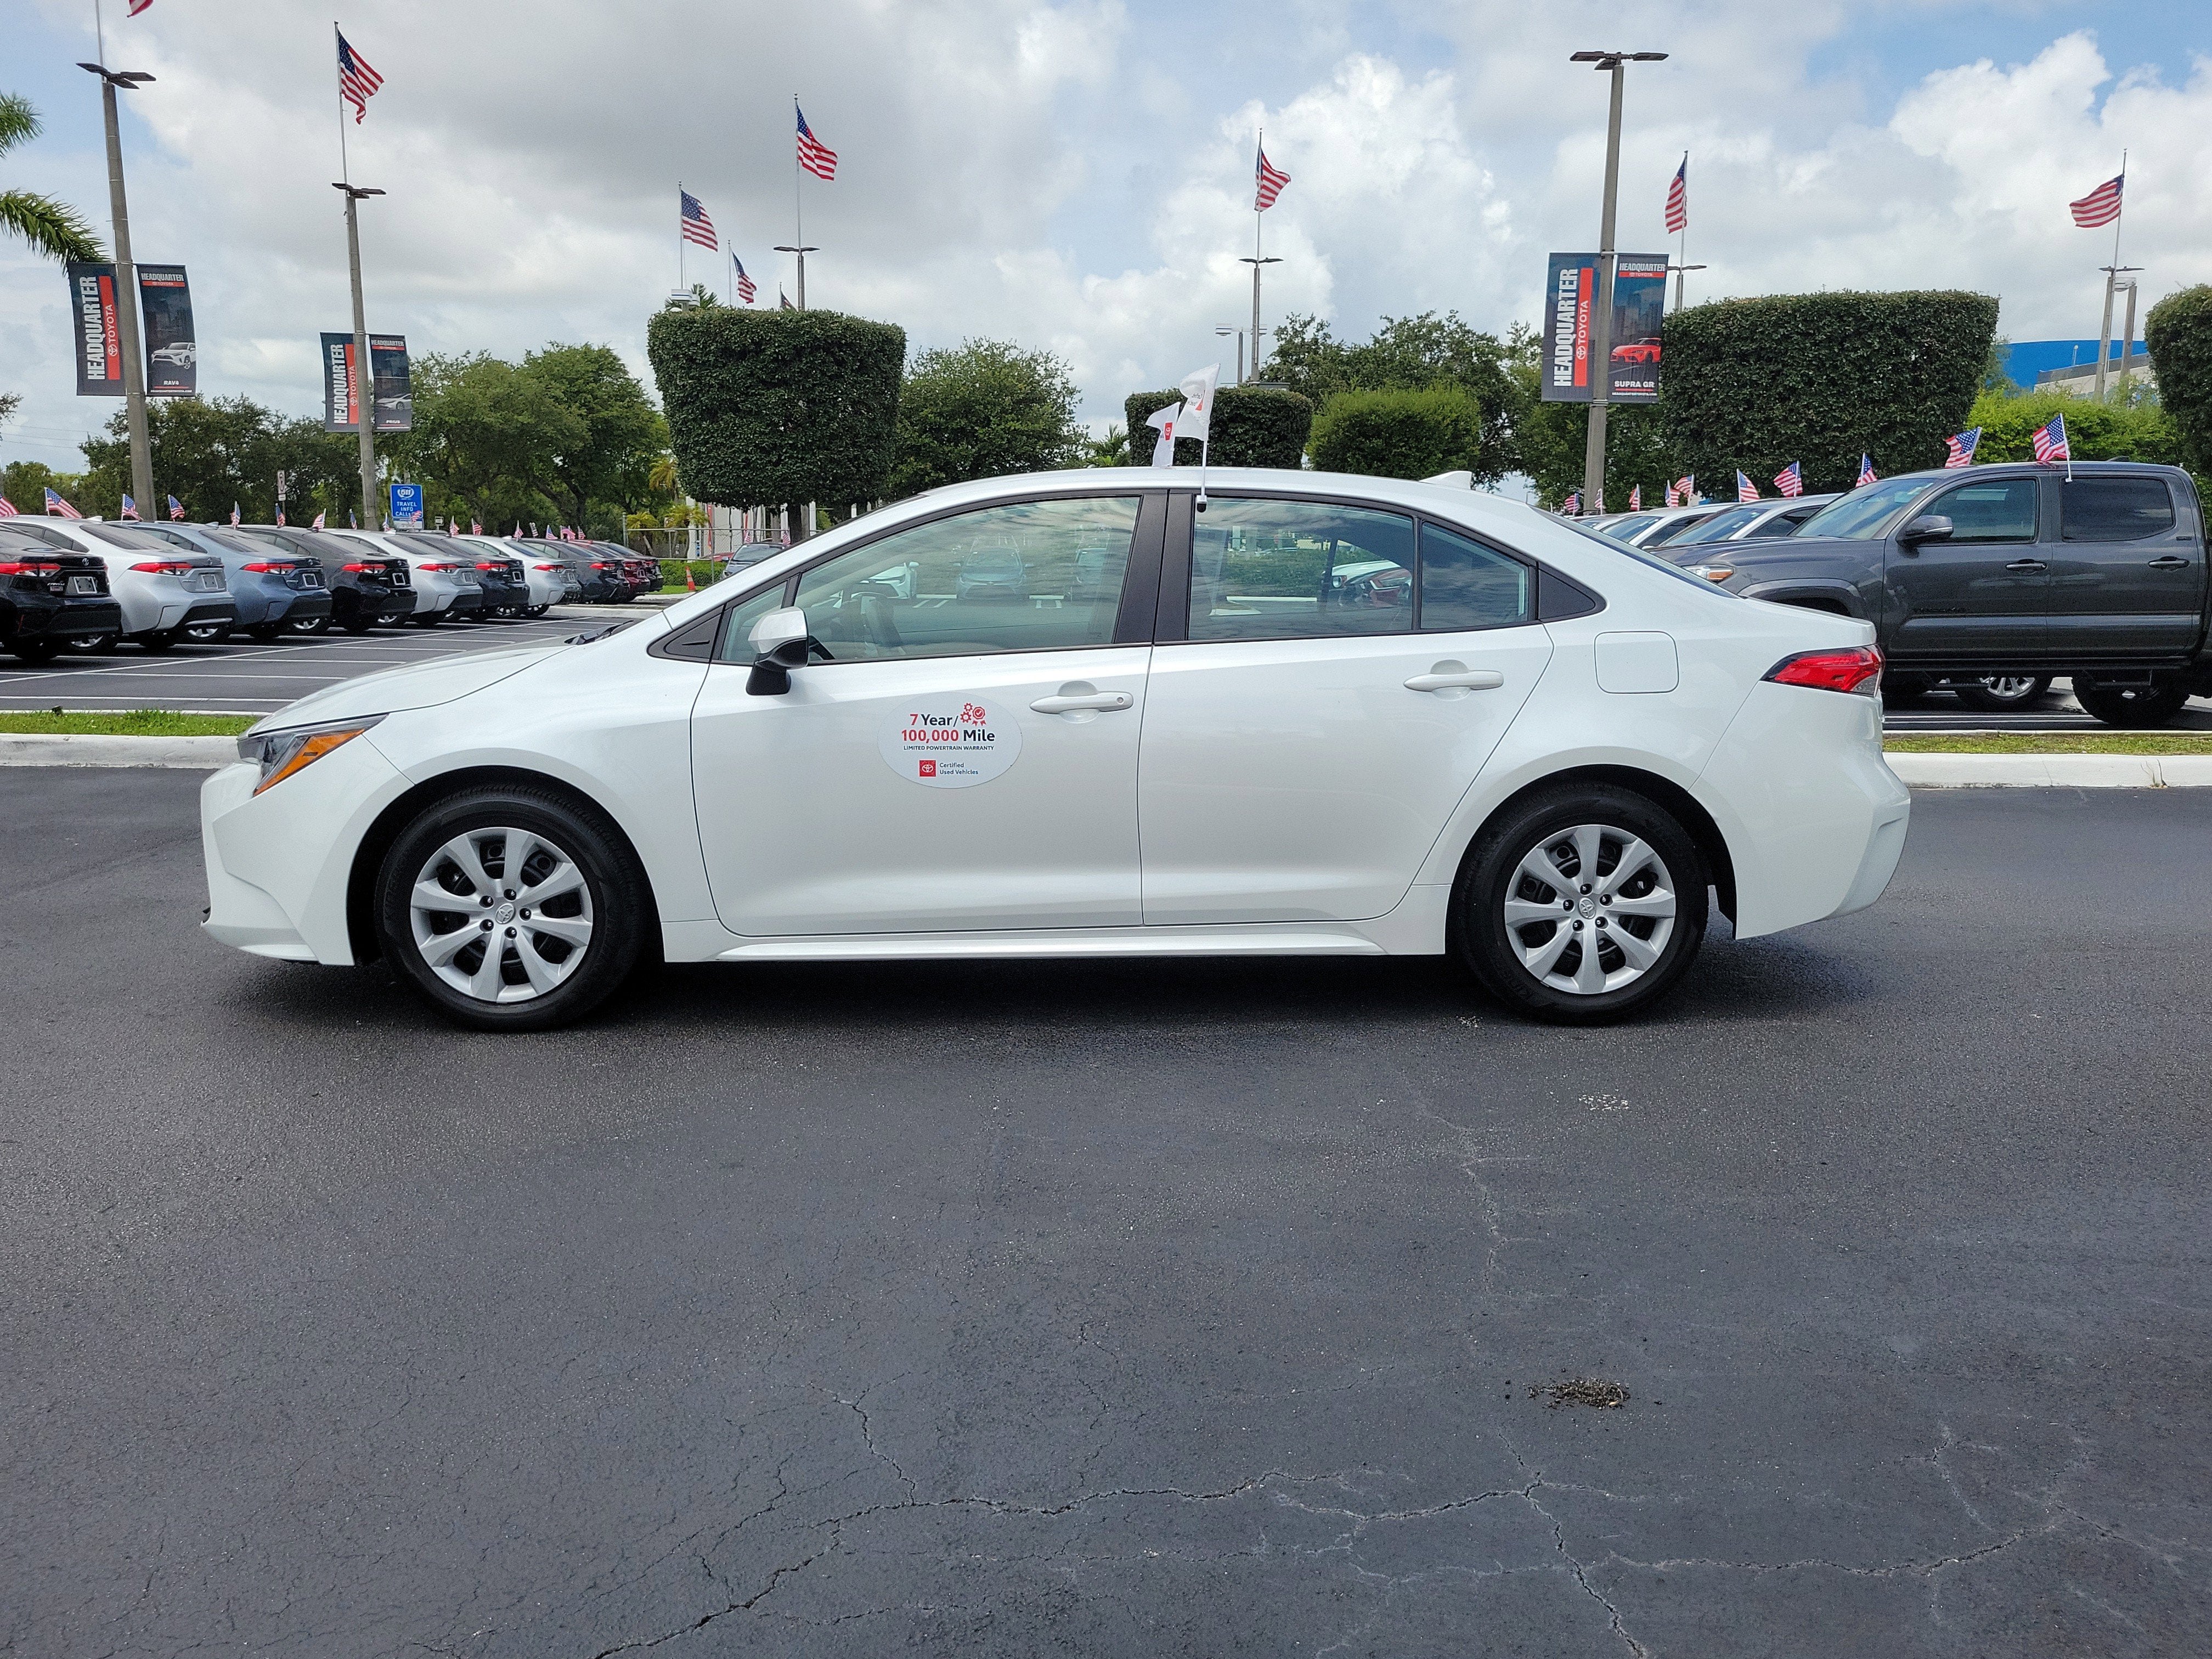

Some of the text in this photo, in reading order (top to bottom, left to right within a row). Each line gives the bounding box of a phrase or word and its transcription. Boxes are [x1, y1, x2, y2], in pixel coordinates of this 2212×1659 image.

[140, 273, 184, 281] HEADQUARTER
[1619, 263, 1666, 272] HEADQUARTER
[80, 276, 106, 380] HEADQUARTER
[105, 304, 116, 343] TOYOTA
[1554, 269, 1578, 387] HEADQUARTER
[1578, 300, 1589, 344] TOYOTA
[330, 344, 349, 424] HEADQUARTER
[901, 729, 995, 743] 100,000 Mile
[910, 713, 959, 727] 7 Year/
